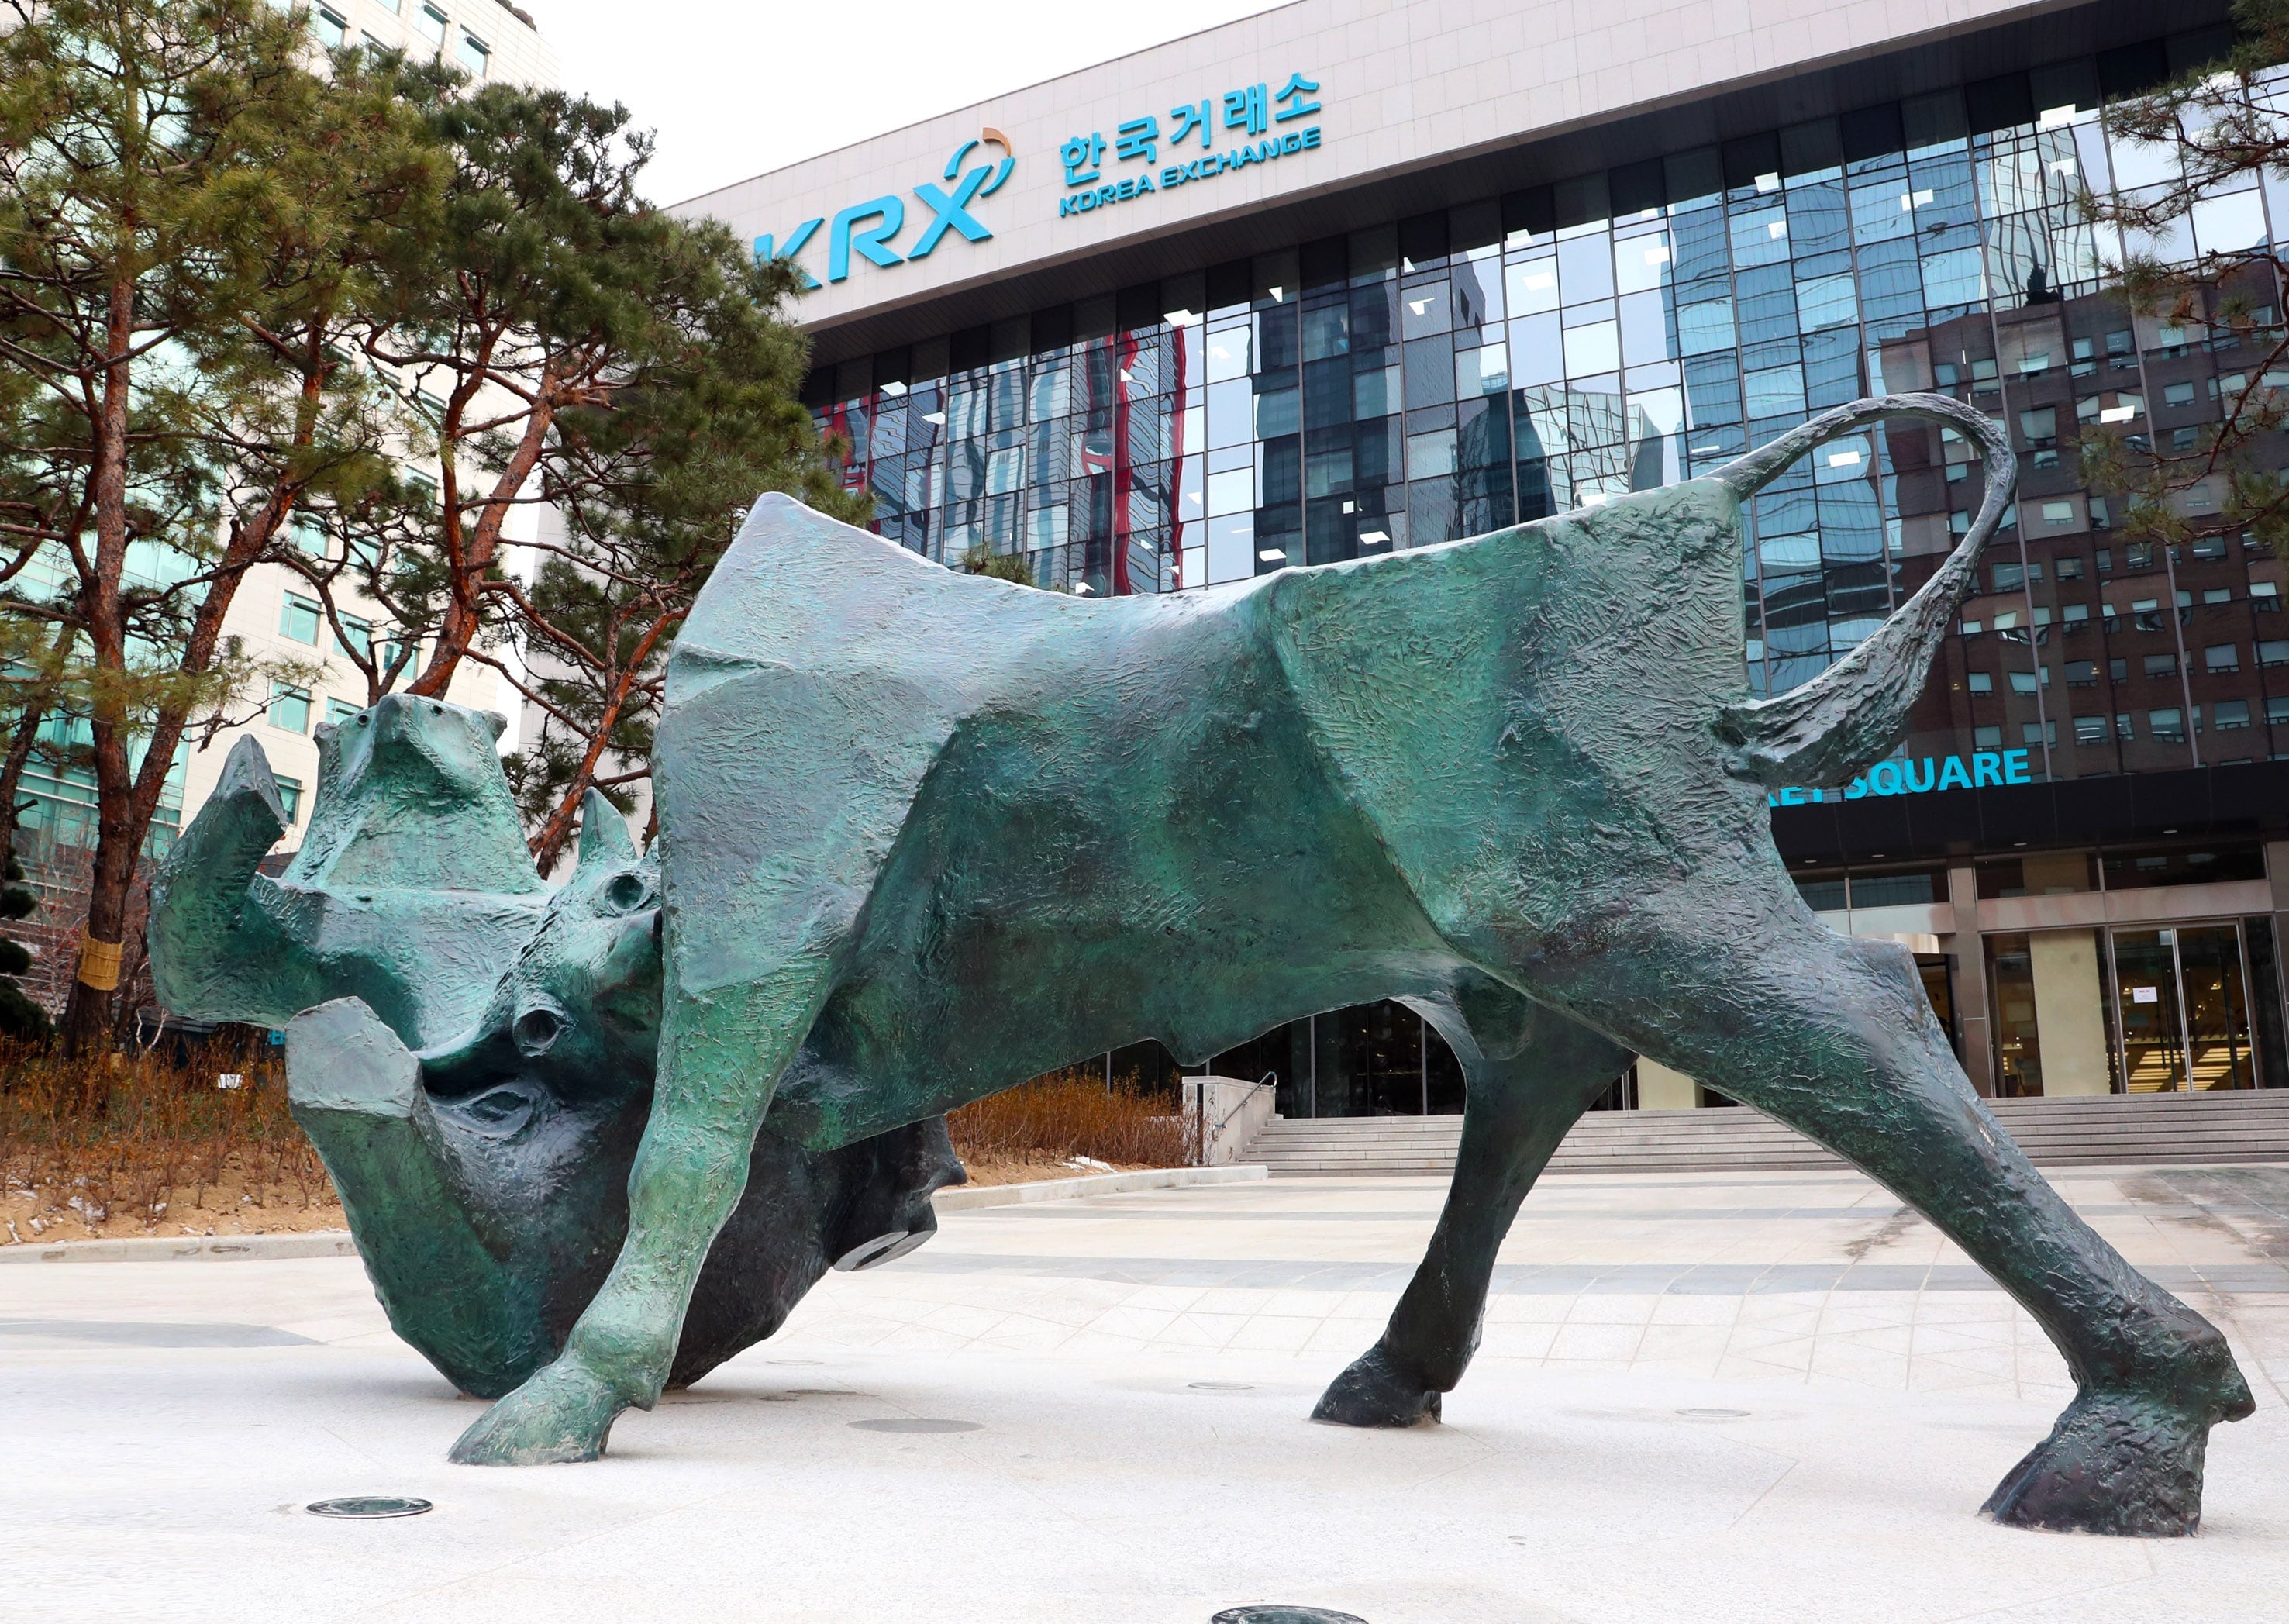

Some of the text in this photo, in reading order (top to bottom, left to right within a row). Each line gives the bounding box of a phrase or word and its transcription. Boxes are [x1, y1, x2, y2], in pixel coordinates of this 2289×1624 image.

[1060, 72, 1322, 187] 한국거래소
[1060, 126, 1322, 218] KOREA EXCHANGE
[750, 164, 995, 305] KRX
